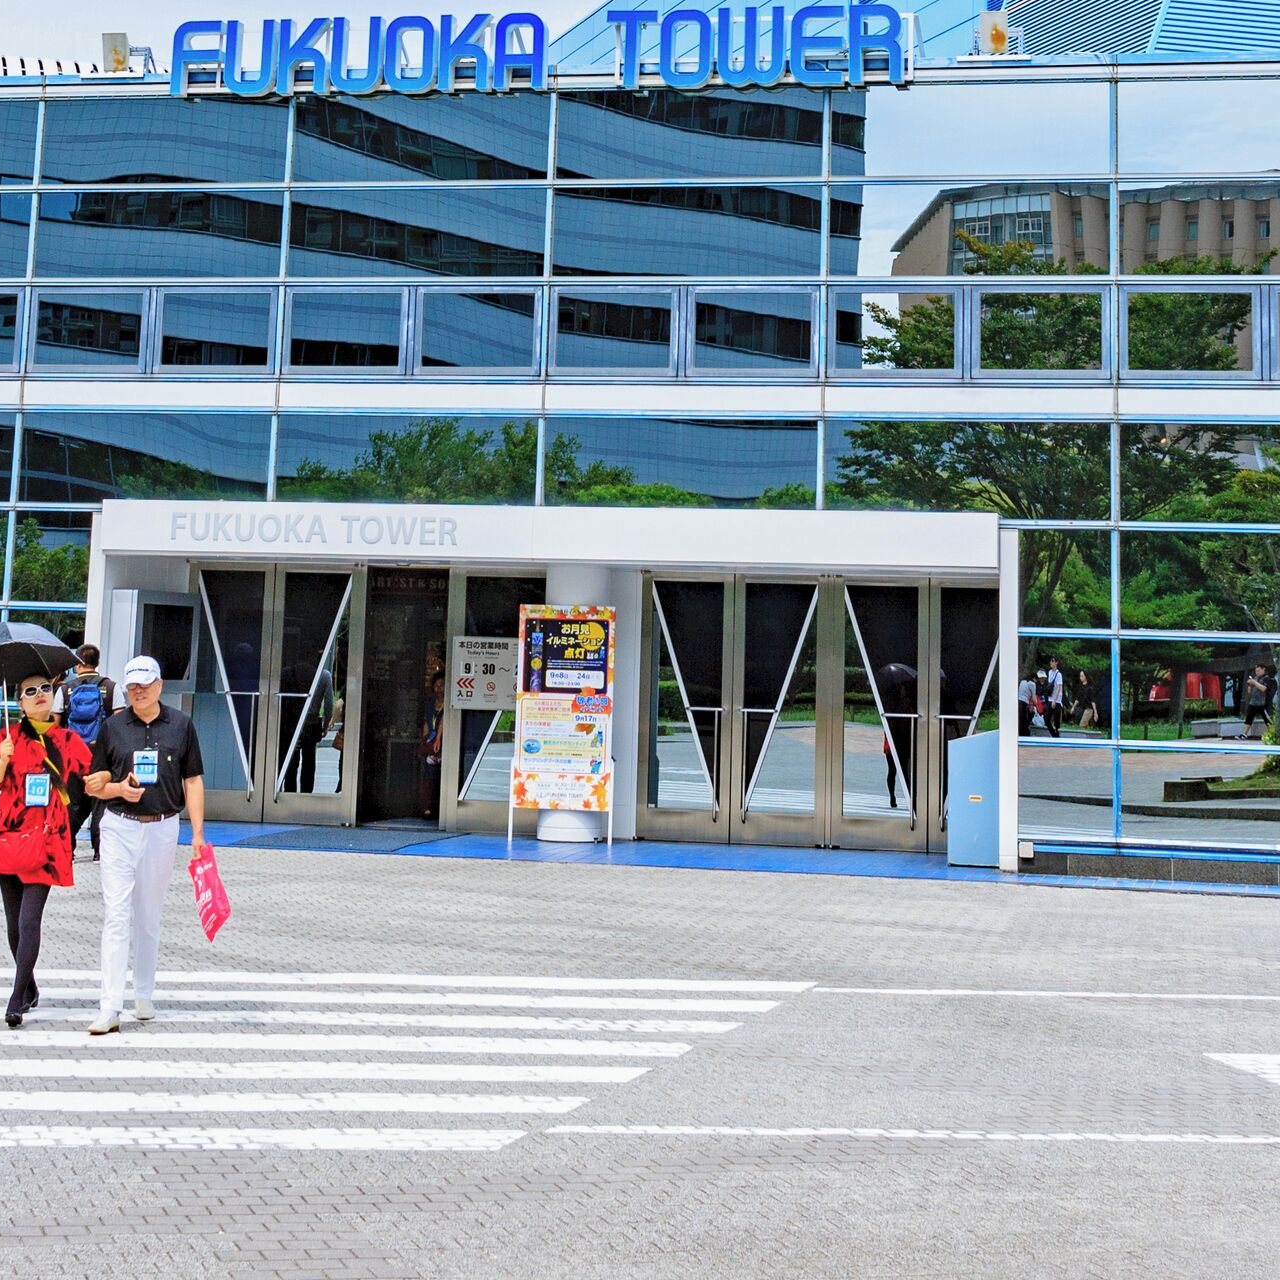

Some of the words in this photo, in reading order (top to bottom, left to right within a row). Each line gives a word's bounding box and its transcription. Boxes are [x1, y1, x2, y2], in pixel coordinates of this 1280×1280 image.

[170, 12, 549, 96] FUKUOKA
[607, 3, 908, 88] TOWER
[170, 511, 328, 543] FUKUOKA
[340, 515, 459, 547] TOWER
[561, 623, 590, 635] お月見
[458, 641, 509, 650] 本日の営業時間
[546, 636, 605, 646] イルミネーション
[564, 647, 585, 659] 点灯
[457, 690, 473, 698] 入口
